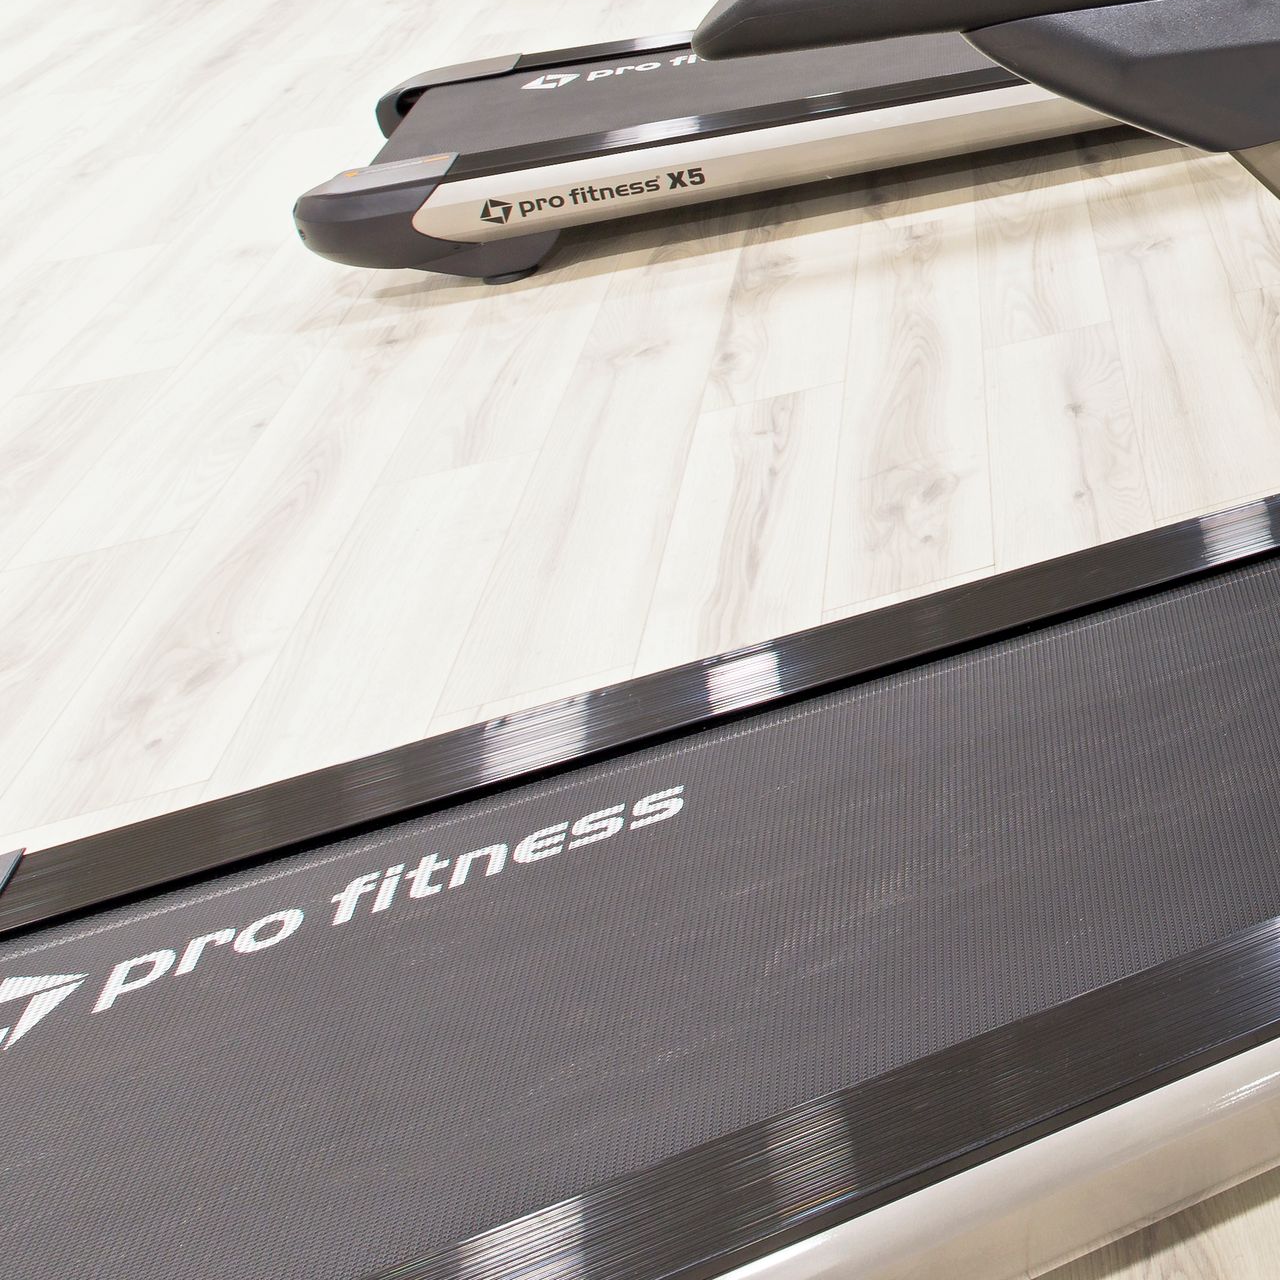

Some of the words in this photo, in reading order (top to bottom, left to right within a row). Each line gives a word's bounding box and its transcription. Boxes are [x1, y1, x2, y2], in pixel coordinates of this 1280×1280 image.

[586, 61, 662, 81] pro
[519, 194, 565, 218] pro
[568, 177, 661, 205] fitness
[666, 167, 706, 190] X5
[90, 907, 305, 1015] pro
[330, 784, 685, 927] fitness
